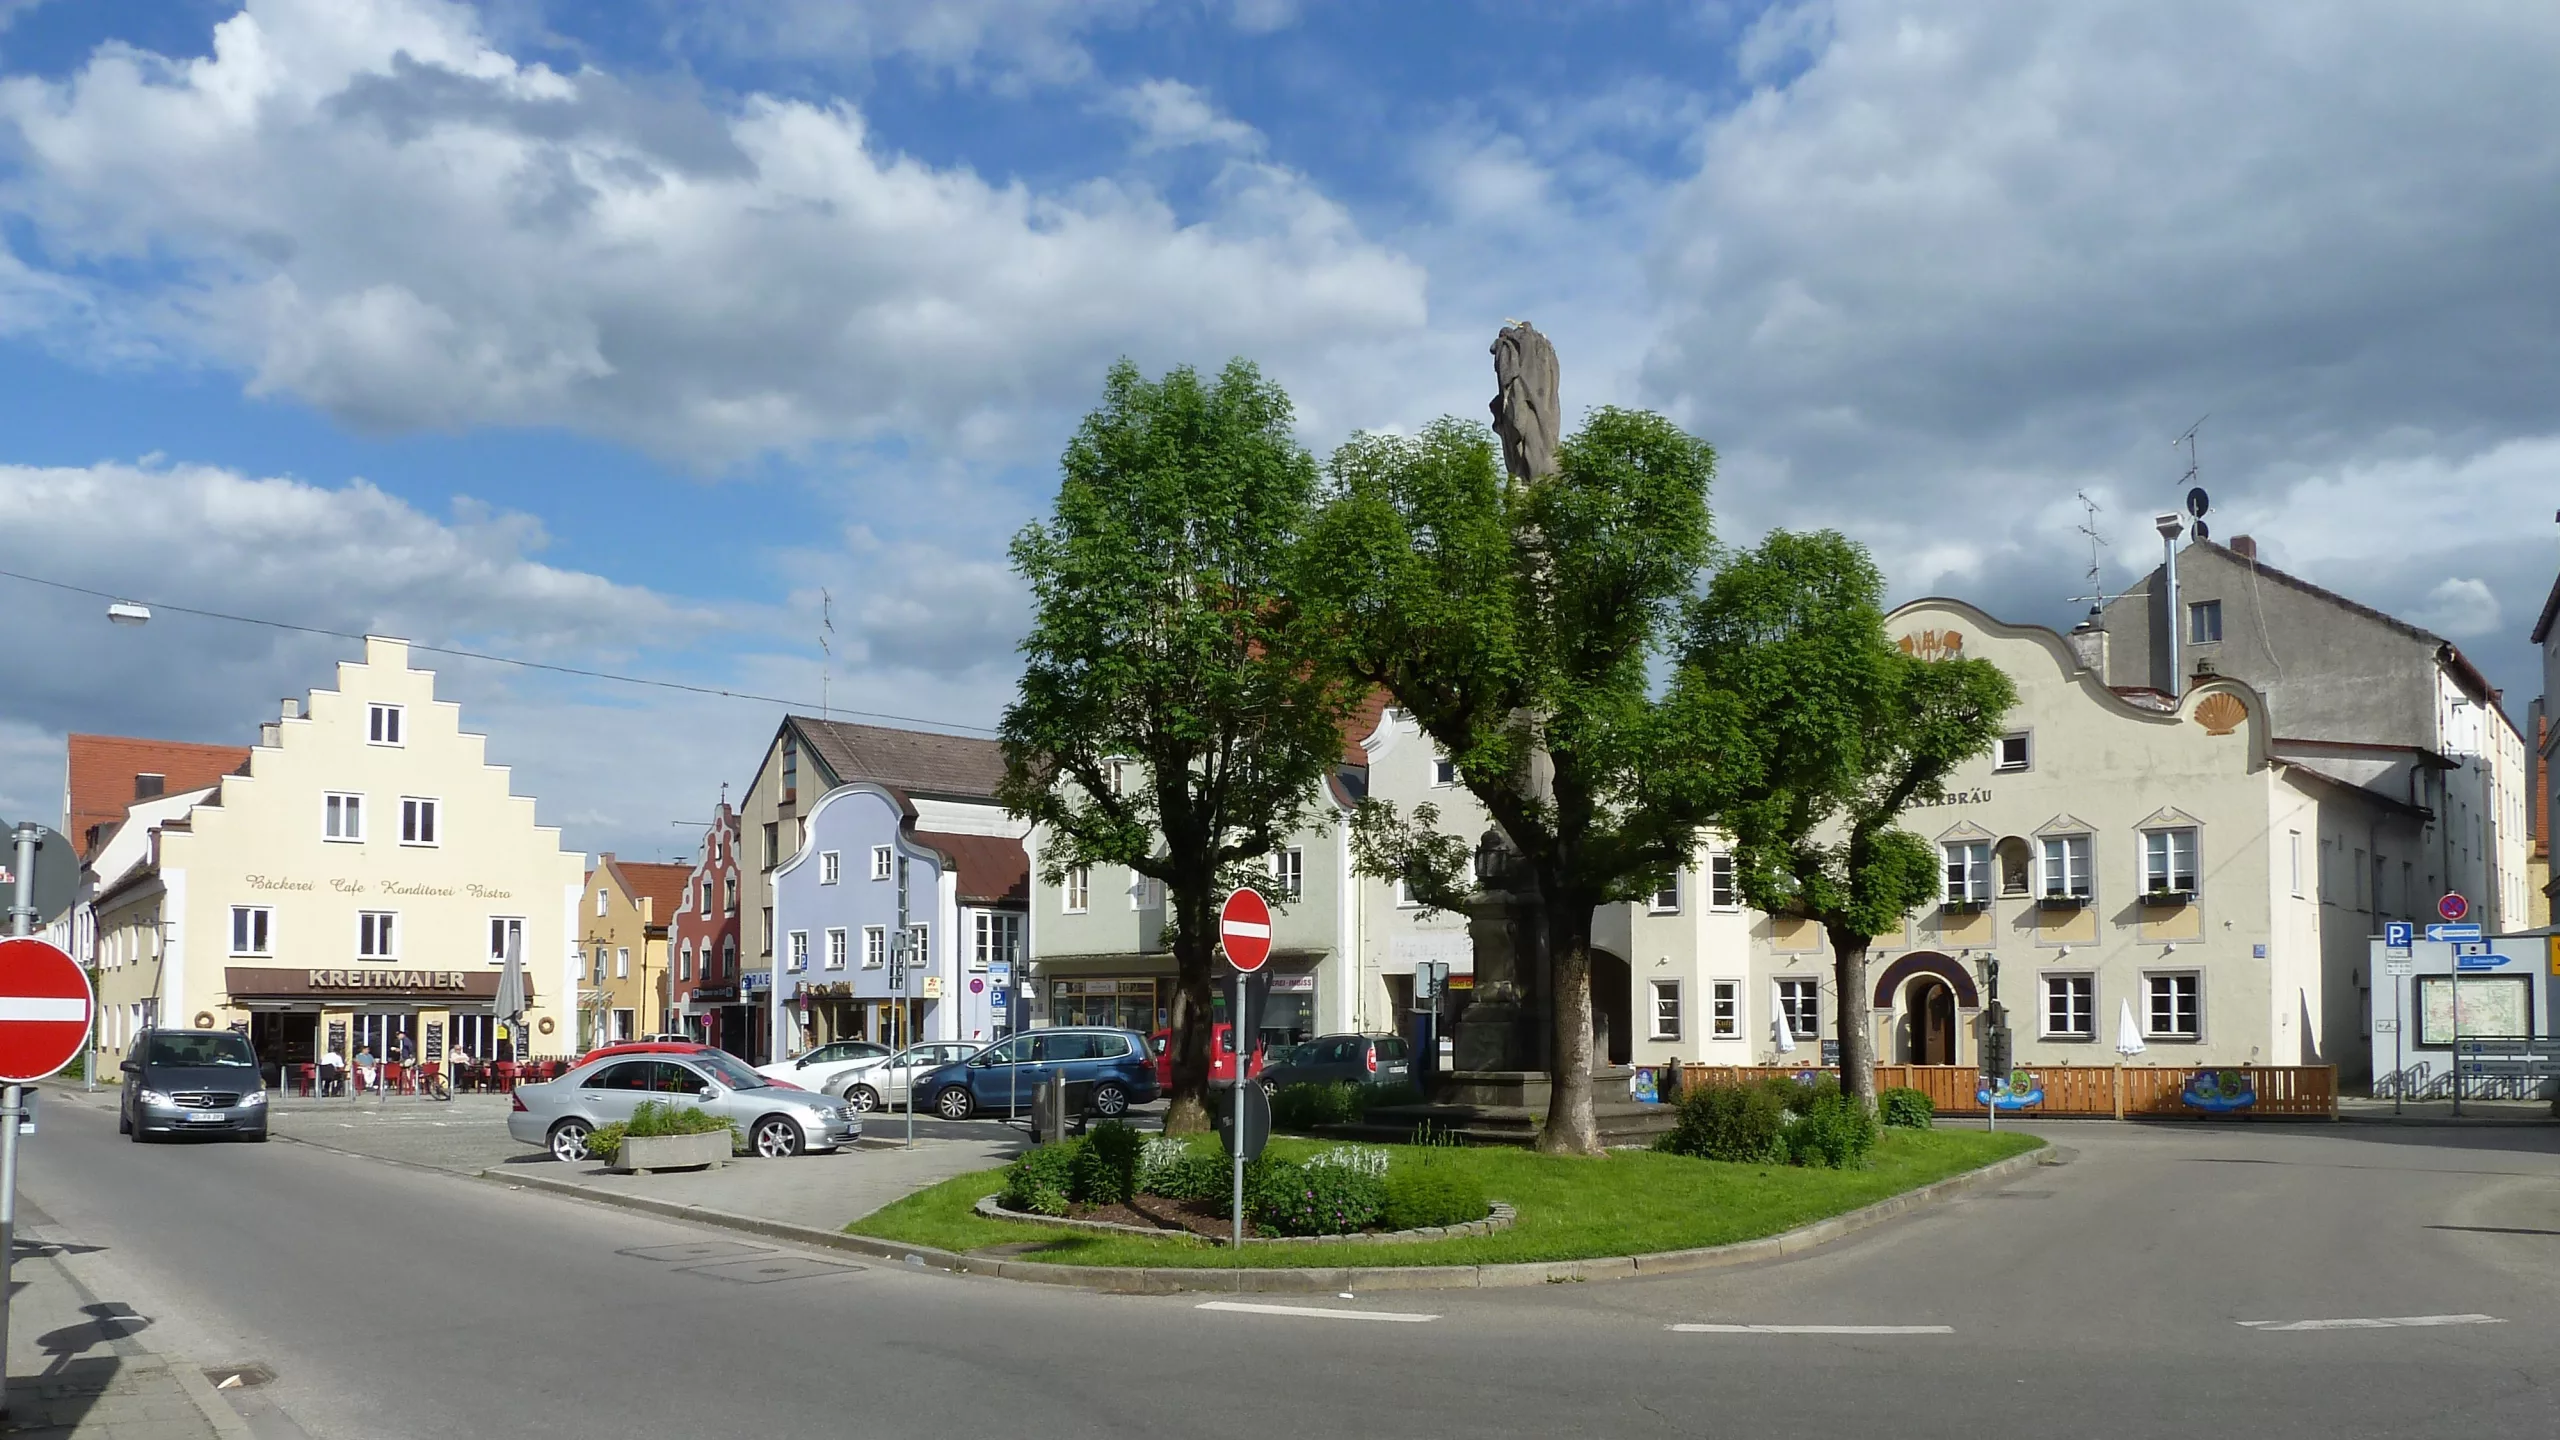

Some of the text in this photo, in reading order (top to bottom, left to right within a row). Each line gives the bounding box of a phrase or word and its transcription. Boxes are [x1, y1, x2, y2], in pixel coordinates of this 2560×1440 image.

[246, 875, 512, 899] Bäckerei Cafe Konditorei Bistro
[2389, 925, 2405, 945] P
[308, 969, 466, 989] KREITMAIER
